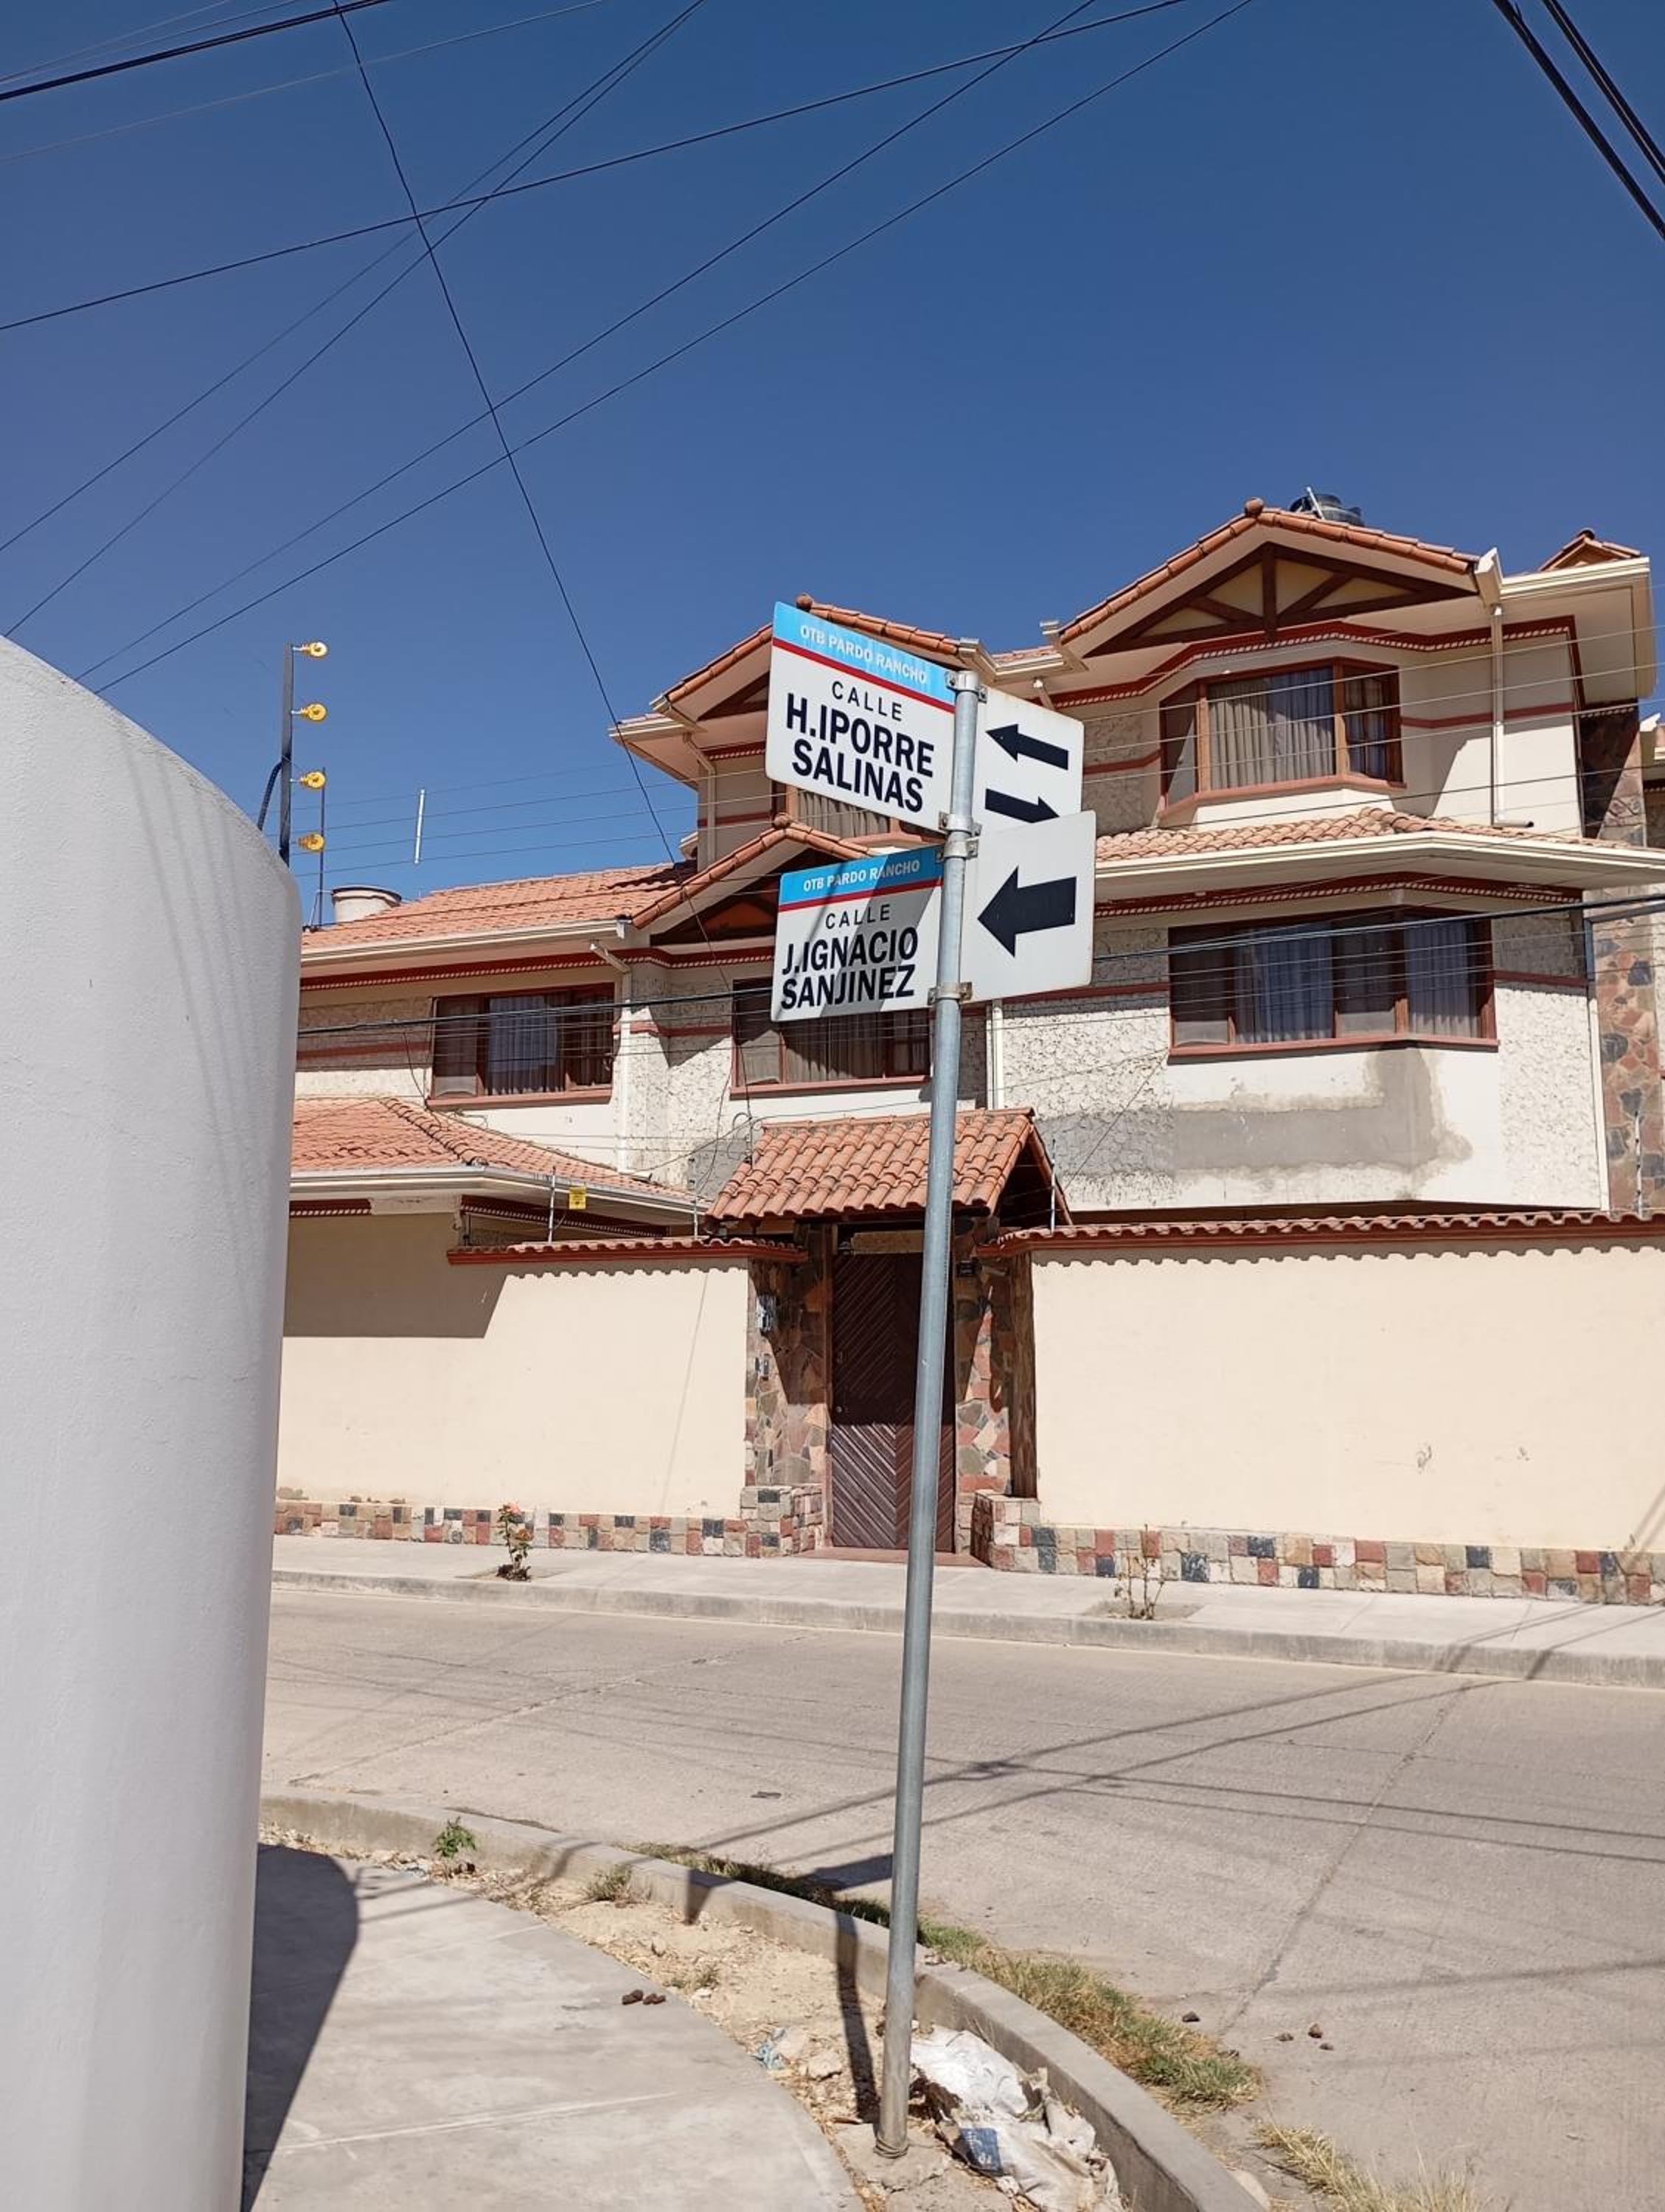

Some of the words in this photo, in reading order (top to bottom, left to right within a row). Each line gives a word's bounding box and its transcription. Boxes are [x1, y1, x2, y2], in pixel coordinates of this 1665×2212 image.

[800, 625, 825, 645] OTB
[829, 636, 872, 663] PARDO
[876, 652, 928, 684] RANCHO
[832, 681, 903, 721] CALLE
[787, 693, 934, 777] H.IPORRE
[792, 740, 923, 813] SALINAS
[804, 876, 824, 892] OTB
[827, 869, 866, 888] PARDO
[869, 859, 920, 882] RANCHO
[826, 904, 890, 929] CALLE
[782, 926, 918, 975] J.IGNACIO
[780, 964, 915, 1009] SANJINEZ
